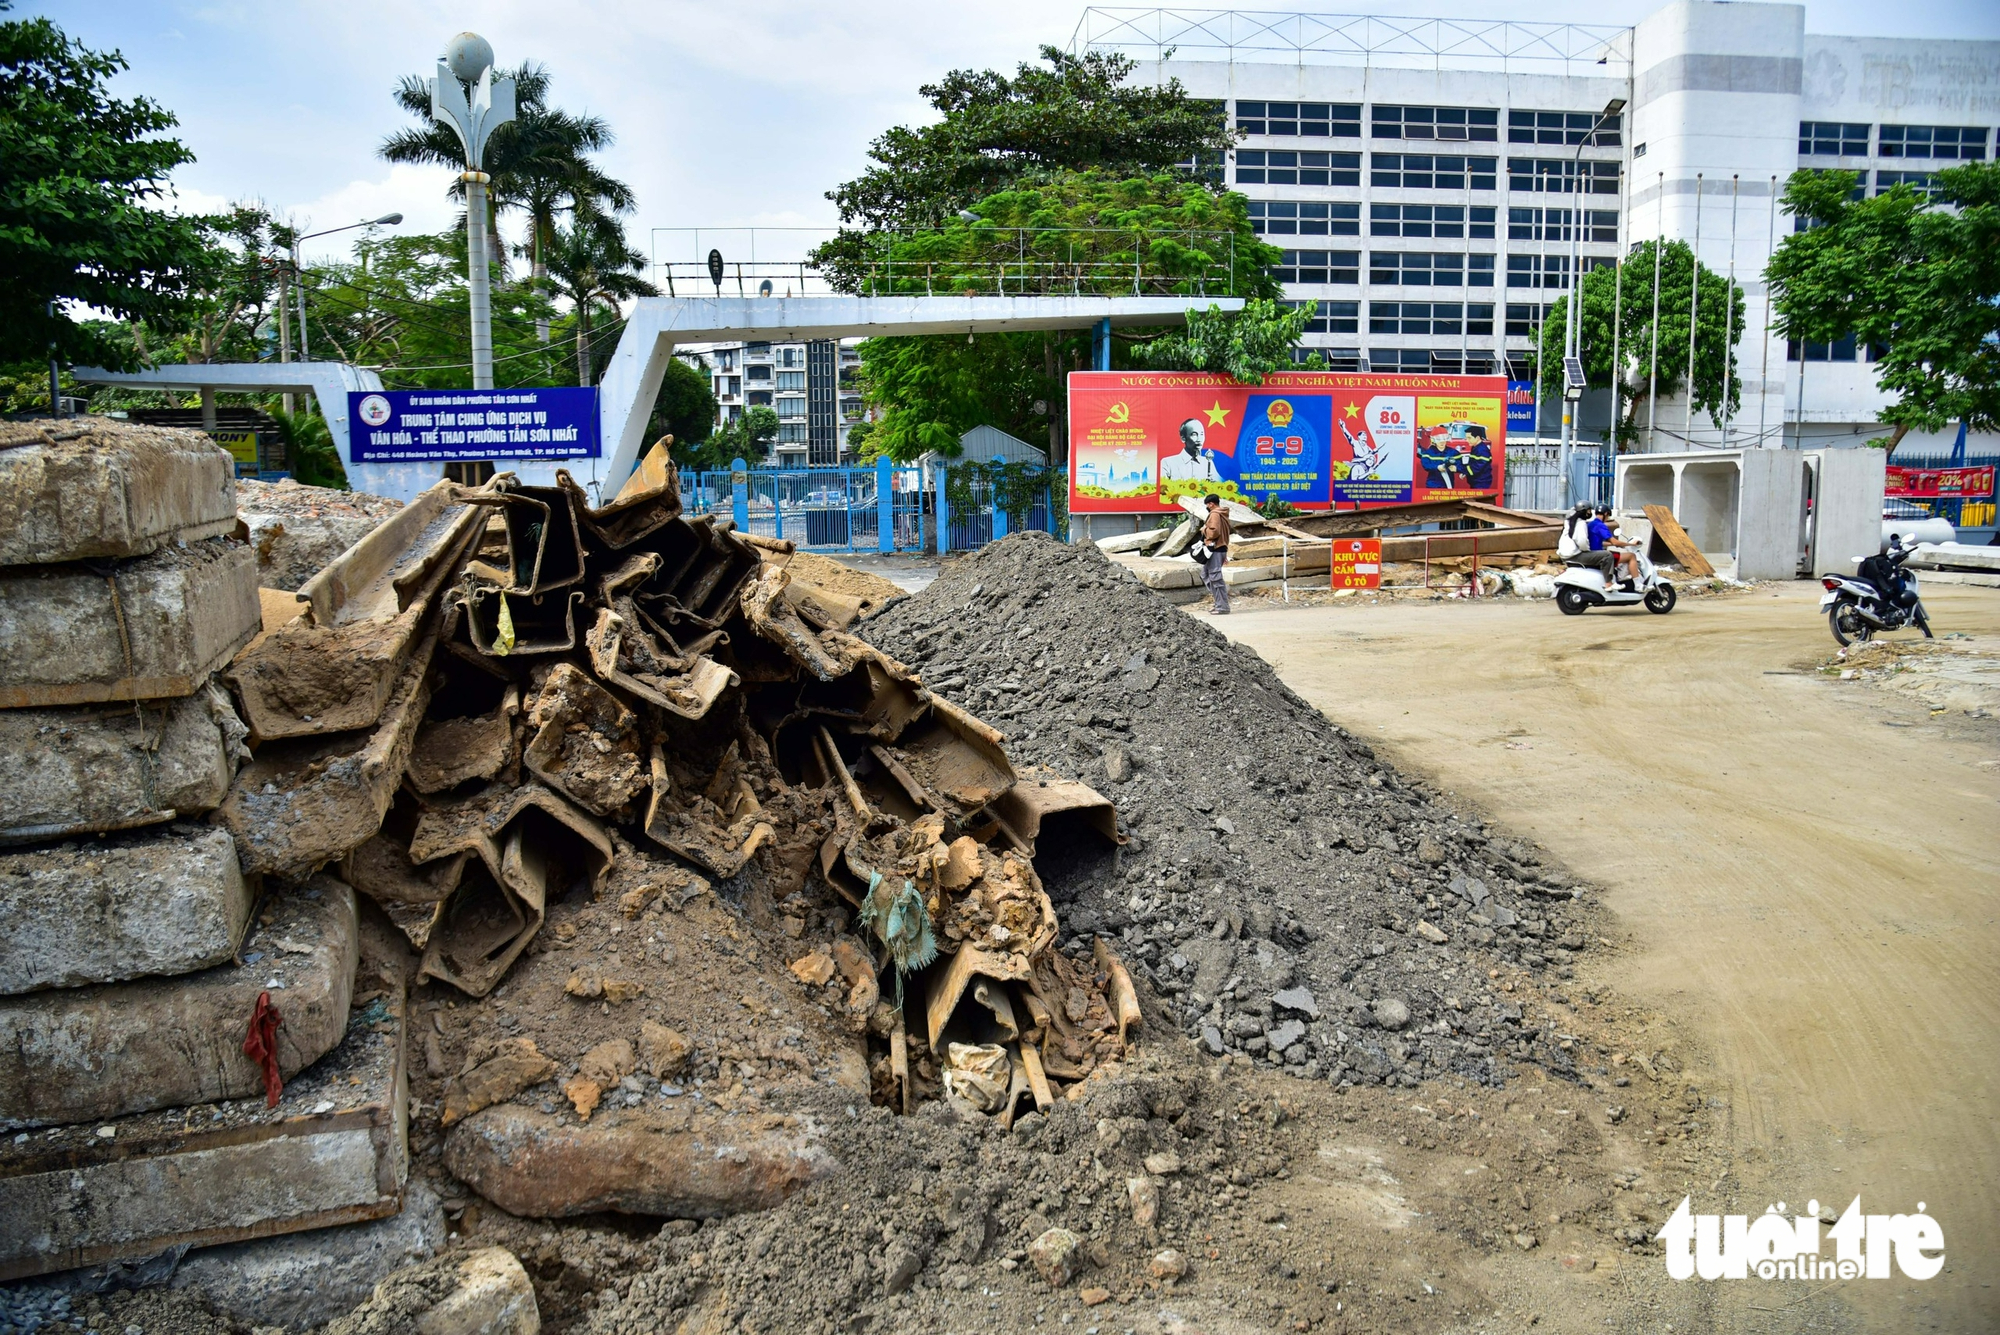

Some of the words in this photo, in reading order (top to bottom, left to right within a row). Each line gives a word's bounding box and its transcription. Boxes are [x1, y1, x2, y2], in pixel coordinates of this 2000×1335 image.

[1121, 376, 1156, 386] NƯỚC
[1158, 377, 1193, 388] CỘNG
[1196, 375, 1222, 386] HÒA
[1269, 376, 1293, 386] CHỦ
[1296, 376, 1334, 386] NGHĨA
[1336, 377, 1362, 388] VIỆT
[1365, 378, 1391, 386] NAM
[1394, 376, 1428, 387] MUÔN
[1431, 377, 1460, 388] NĂM!
[400, 414, 433, 427] TRUNG
[434, 411, 455, 426] TÂM
[457, 413, 484, 426] CUNG
[486, 410, 507, 425] ỨNG
[509, 412, 532, 427] DỊCH
[533, 411, 547, 426] VỤ
[1380, 411, 1400, 424] 80
[370, 430, 390, 445] VĂN
[392, 430, 412, 445] HÓA
[420, 427, 439, 444] THỂ
[440, 431, 465, 444] THAO
[467, 427, 507, 443] PHƯỜNG
[508, 428, 528, 442] TÂN
[530, 428, 550, 442] SƠN
[552, 424, 578, 442] NHẤT
[1256, 436, 1303, 455] 2-9
[1938, 475, 1963, 485] 20%
[1335, 553, 1356, 561] KHU
[1358, 551, 1378, 563] VỰC
[1334, 562, 1355, 574] CẤM
[1345, 576, 1352, 586] Ô
[1354, 576, 1367, 586] TÔ
